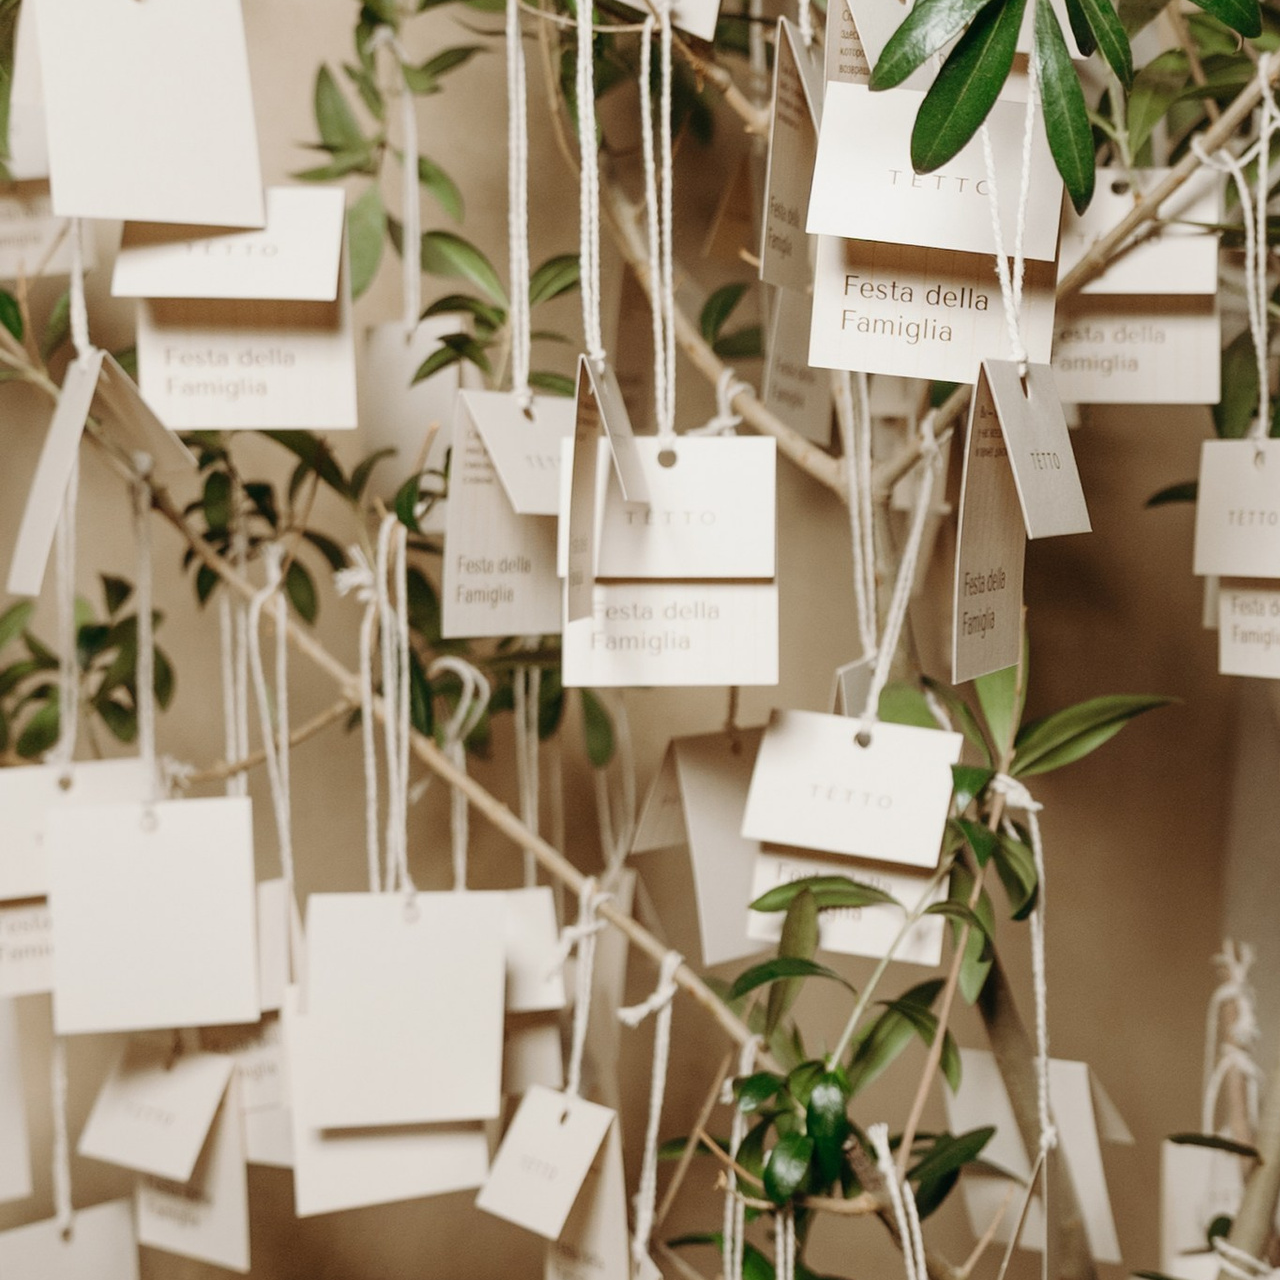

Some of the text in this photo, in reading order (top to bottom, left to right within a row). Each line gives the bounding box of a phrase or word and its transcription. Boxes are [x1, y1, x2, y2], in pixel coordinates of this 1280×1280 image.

[844, 275, 989, 311] Festa della
[841, 309, 953, 345] Famiglia
[1058, 325, 1105, 344] esta
[1057, 353, 1139, 377] amiglia
[662, 601, 721, 621] della
[590, 631, 692, 656] Famiglia
